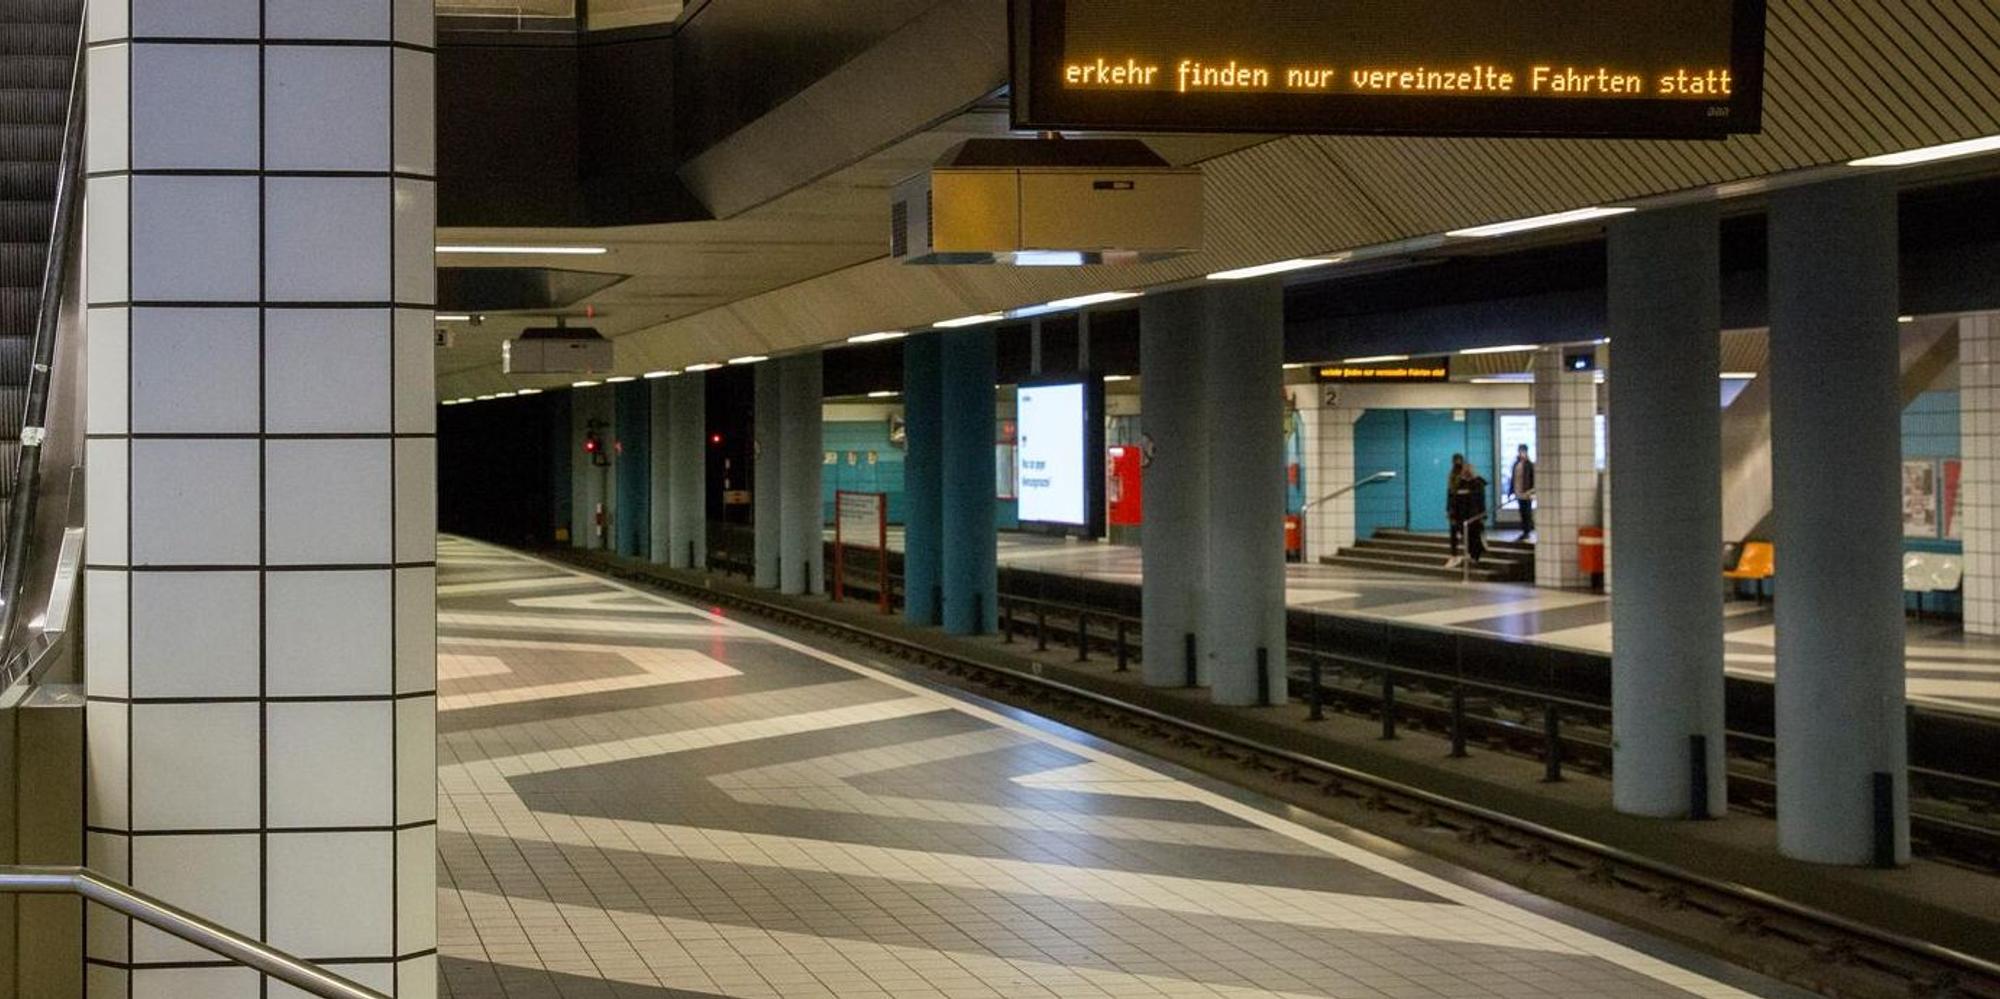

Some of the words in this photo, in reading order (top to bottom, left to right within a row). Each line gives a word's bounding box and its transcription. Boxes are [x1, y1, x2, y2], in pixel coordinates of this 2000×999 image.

[1065, 58, 1158, 85] erkehr
[1177, 59, 1269, 93] finden
[1287, 69, 1334, 88] nur
[1353, 65, 1514, 91] vereinzelte
[1532, 66, 1641, 93] Fahrten
[1659, 69, 1732, 94] statt
[1326, 390, 1337, 406] 2
